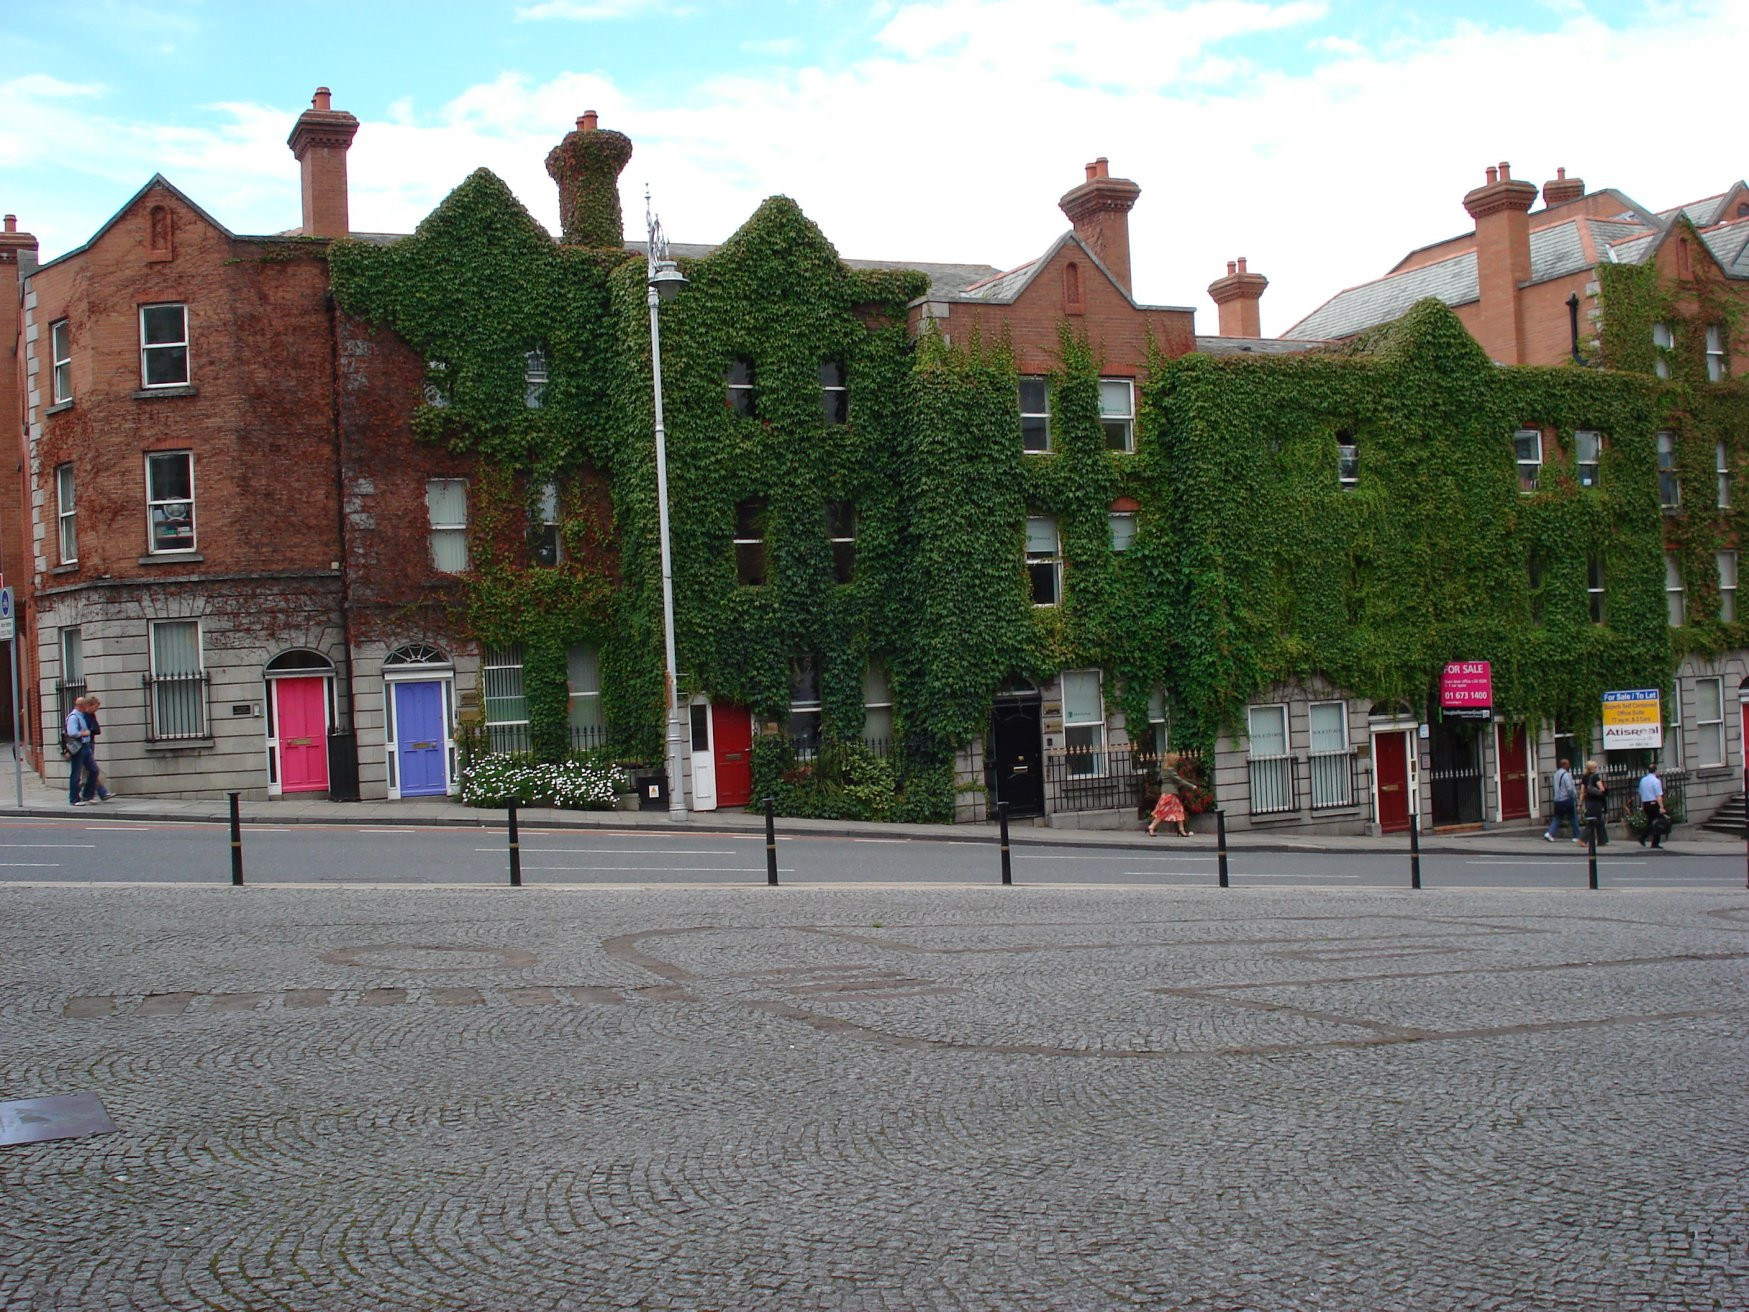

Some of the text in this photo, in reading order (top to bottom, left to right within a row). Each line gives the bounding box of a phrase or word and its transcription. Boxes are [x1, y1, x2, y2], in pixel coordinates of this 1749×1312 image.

[1443, 665, 1483, 674] FOR SALE
[1471, 691, 1487, 699] 1400
[1603, 693, 1615, 702] For
[1616, 692, 1631, 701] Sale
